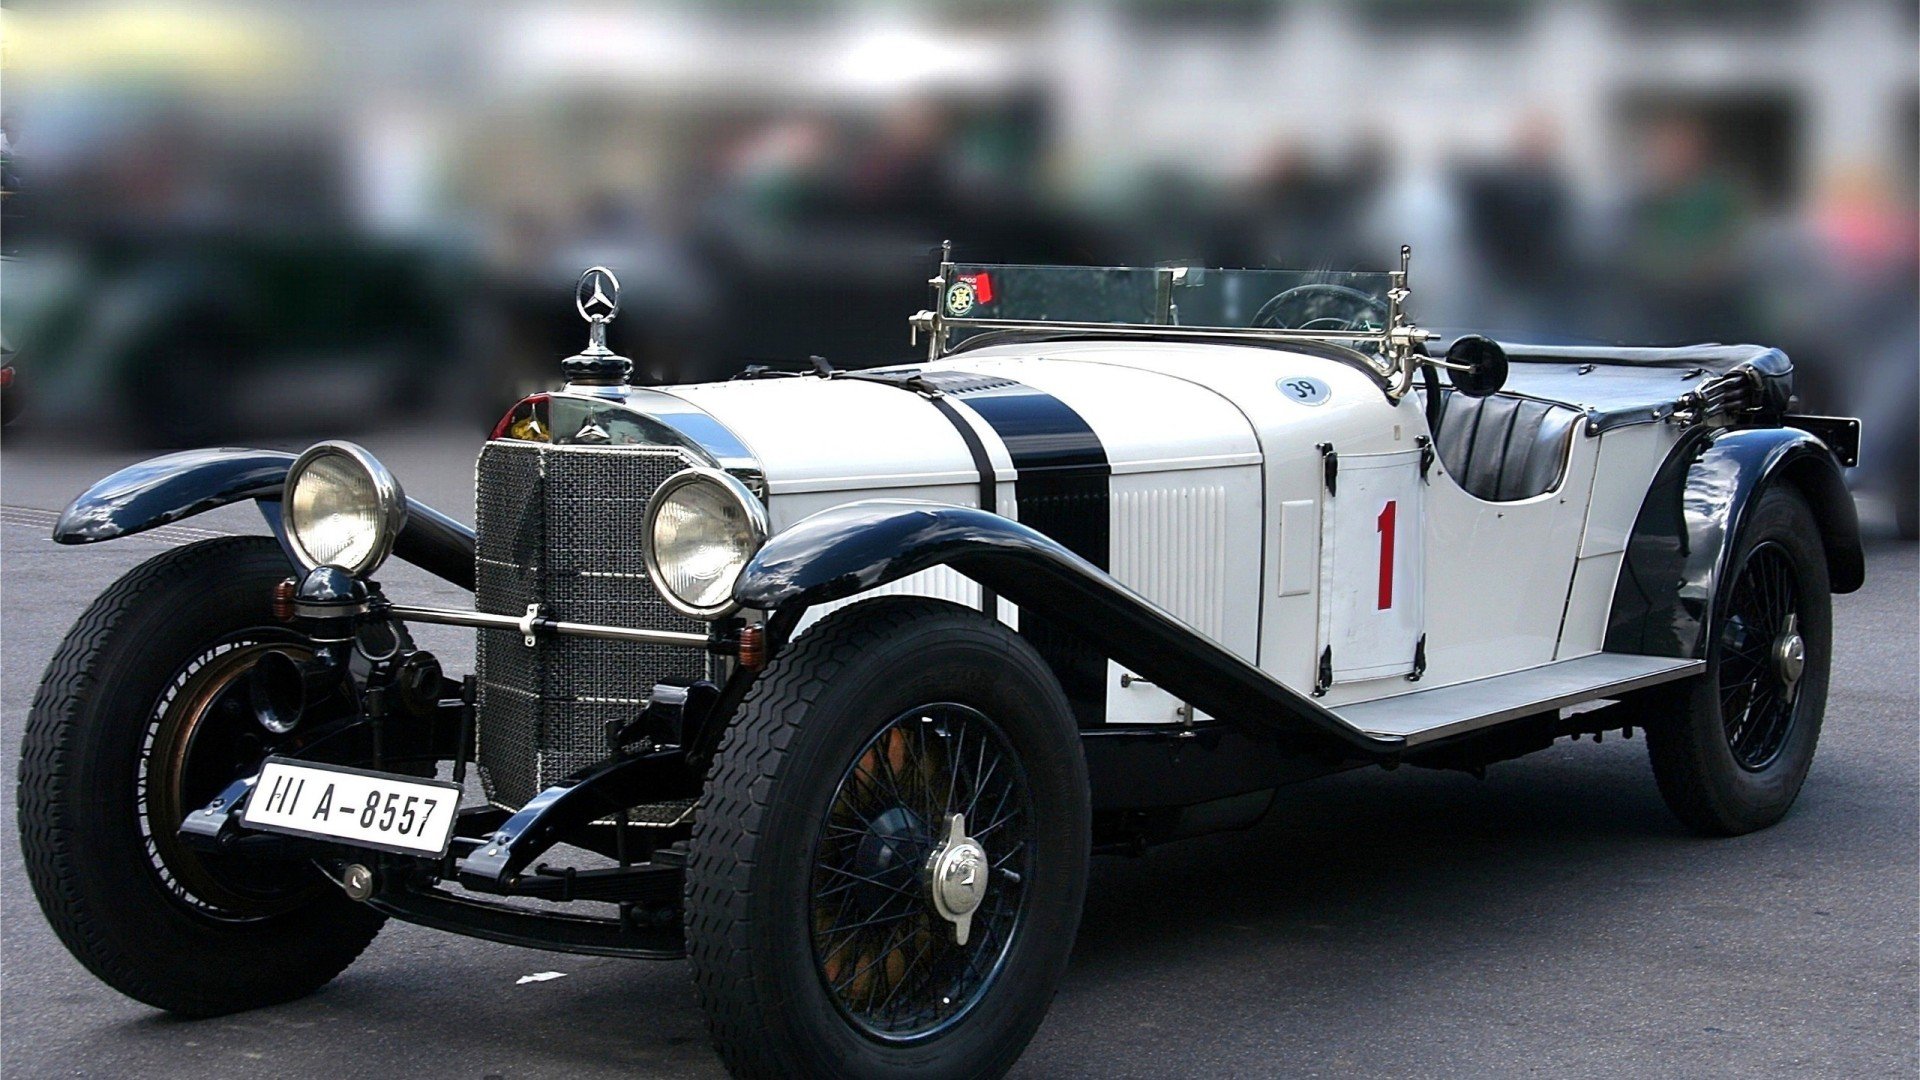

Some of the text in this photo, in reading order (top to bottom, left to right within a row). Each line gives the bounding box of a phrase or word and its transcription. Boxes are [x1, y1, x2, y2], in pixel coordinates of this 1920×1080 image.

[1286, 380, 1317, 398] 39
[1377, 500, 1396, 610] 1
[312, 783, 437, 837] A-8557
